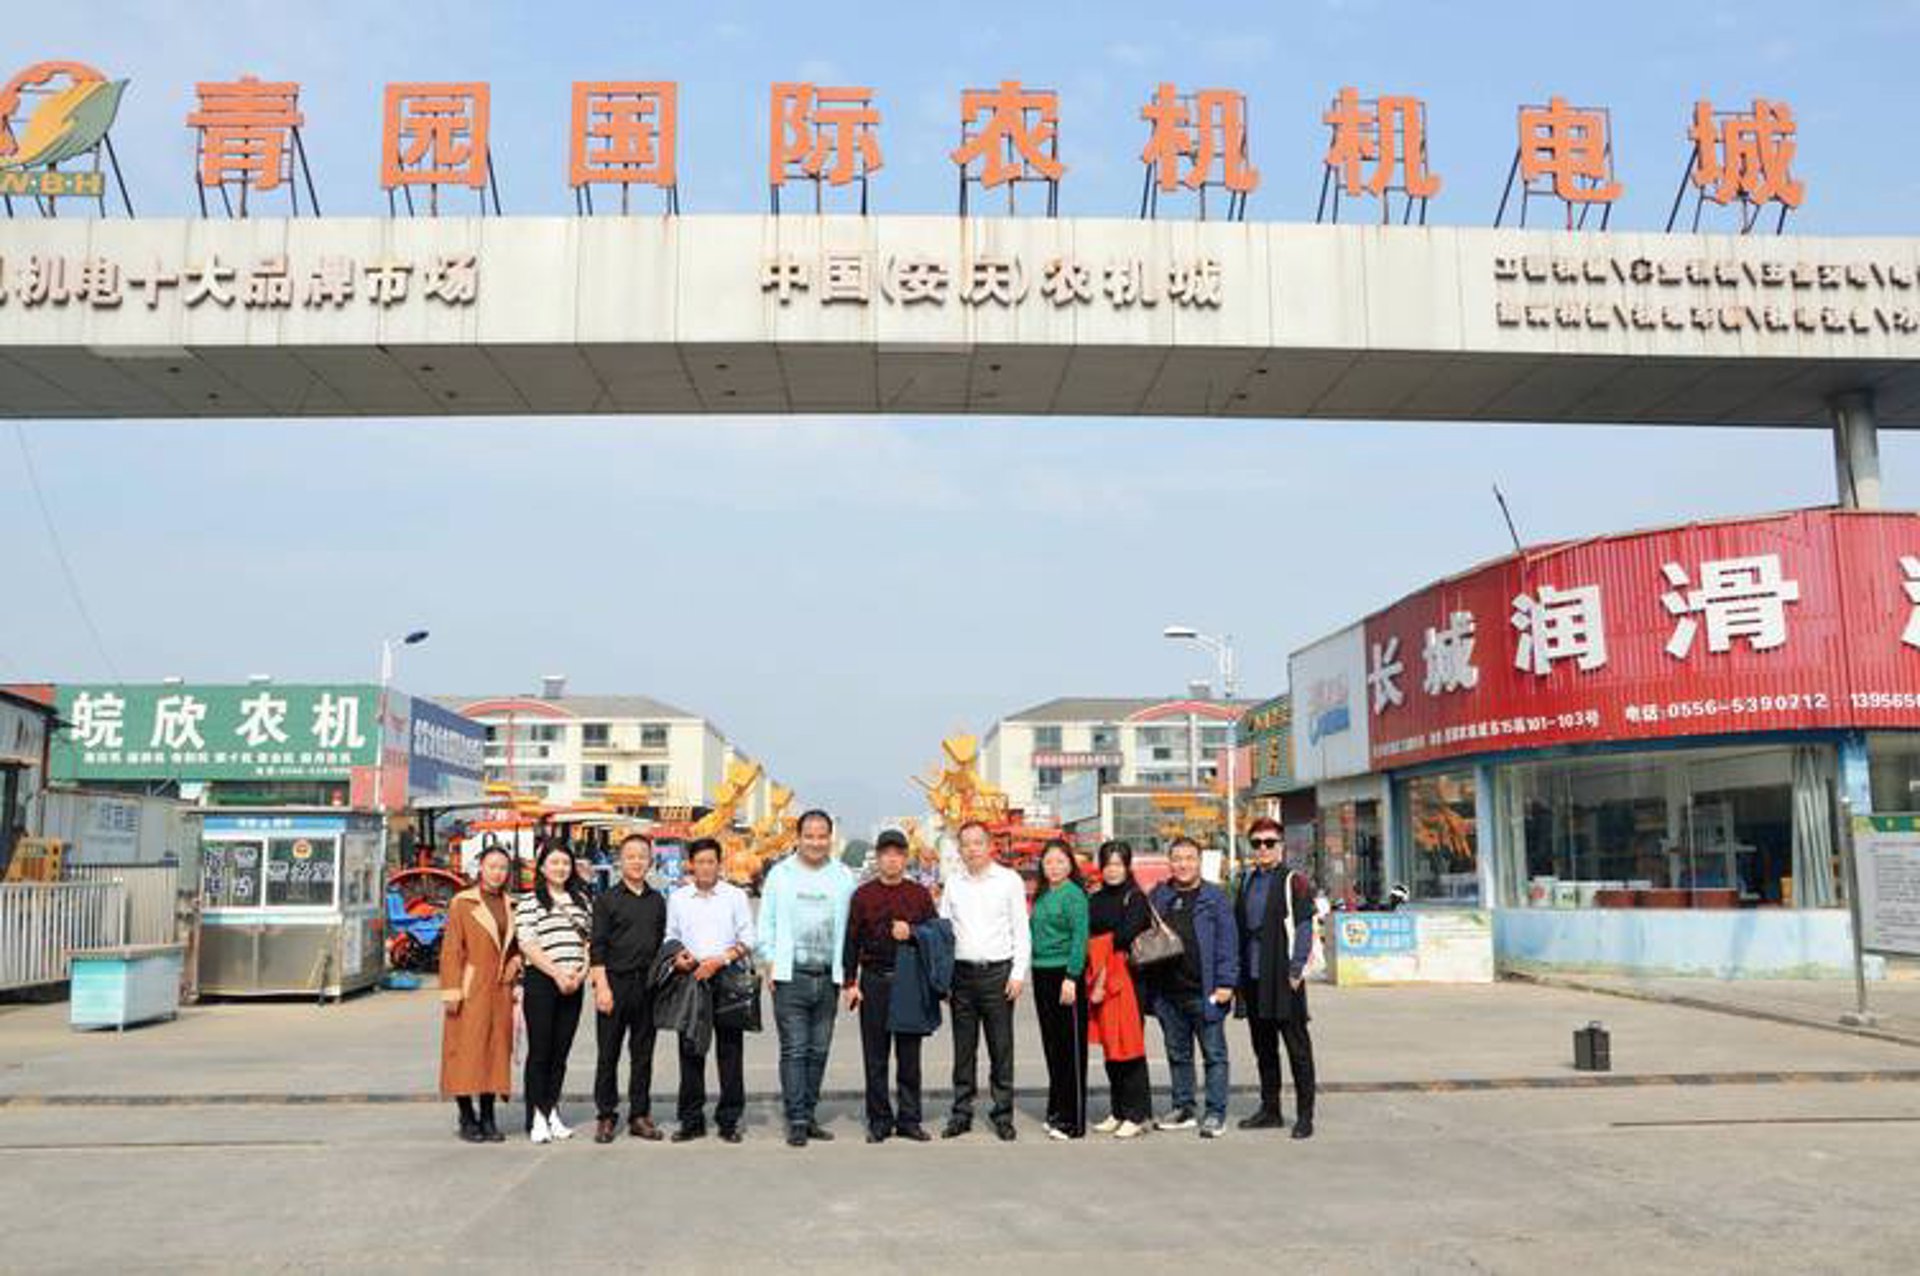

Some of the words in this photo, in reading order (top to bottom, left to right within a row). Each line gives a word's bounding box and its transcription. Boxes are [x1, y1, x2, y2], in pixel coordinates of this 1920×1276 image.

[187, 75, 1805, 208] 青园国际农机机电城
[0, 252, 480, 310] 机电十大品牌市场
[71, 692, 366, 750] 皖欣农机
